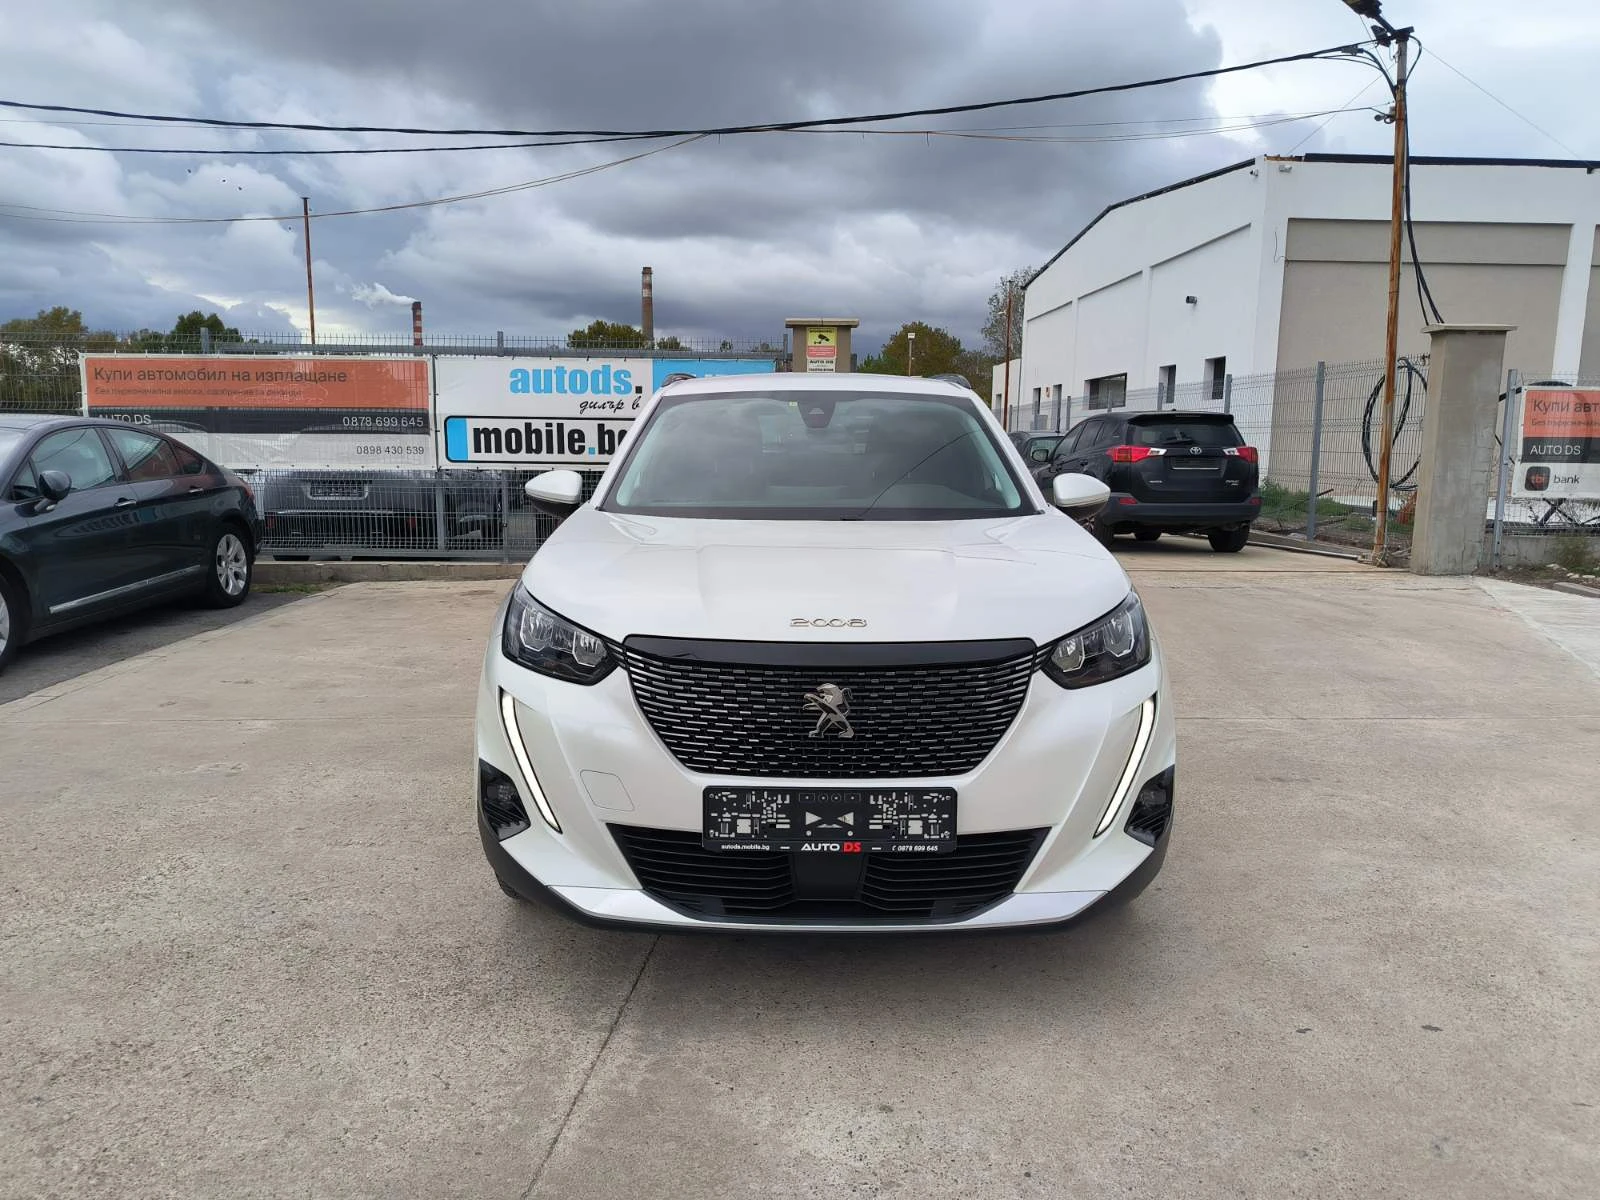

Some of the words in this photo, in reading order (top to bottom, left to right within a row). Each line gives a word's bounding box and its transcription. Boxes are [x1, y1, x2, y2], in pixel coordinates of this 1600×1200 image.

[94, 367, 133, 384] Купи
[137, 367, 226, 381] автомобил
[231, 371, 251, 381] на
[255, 371, 347, 384] изплащане
[509, 364, 643, 395] autods.
[1533, 399, 1570, 415] Купи
[1574, 402, 1600, 413] авт
[134, 414, 152, 425] DS
[342, 416, 372, 427] 0878
[375, 416, 398, 427] 699
[401, 416, 424, 427] 645
[356, 446, 382, 455] 0898
[384, 446, 402, 455] 430
[406, 446, 425, 455] 539
[1529, 445, 1562, 455] AUTO
[1565, 445, 1581, 455] DS
[1553, 474, 1580, 484] bank
[789, 618, 868, 628] 2008
[721, 843, 770, 851] autods.mobile.bg
[800, 843, 840, 851] AUTO
[843, 842, 862, 852] DS
